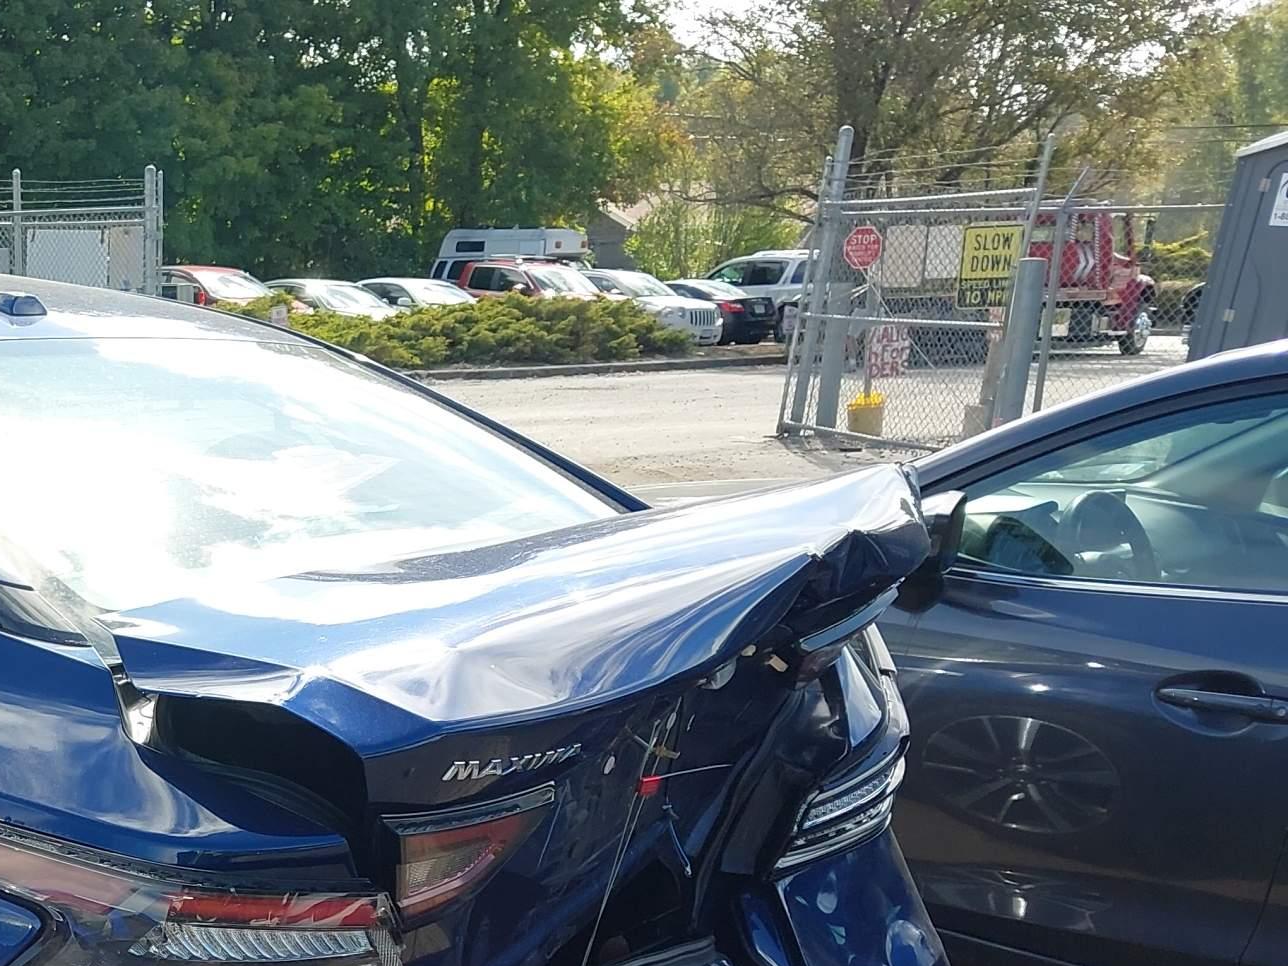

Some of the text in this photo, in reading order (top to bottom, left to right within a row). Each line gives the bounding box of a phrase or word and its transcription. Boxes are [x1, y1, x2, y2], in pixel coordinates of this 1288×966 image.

[849, 234, 877, 245] STOP
[974, 232, 1014, 251] SLOW
[970, 254, 1012, 272] DOWN
[961, 279, 990, 289] SPEED
[965, 290, 981, 304] 10
[442, 743, 582, 781] MAXIMA
